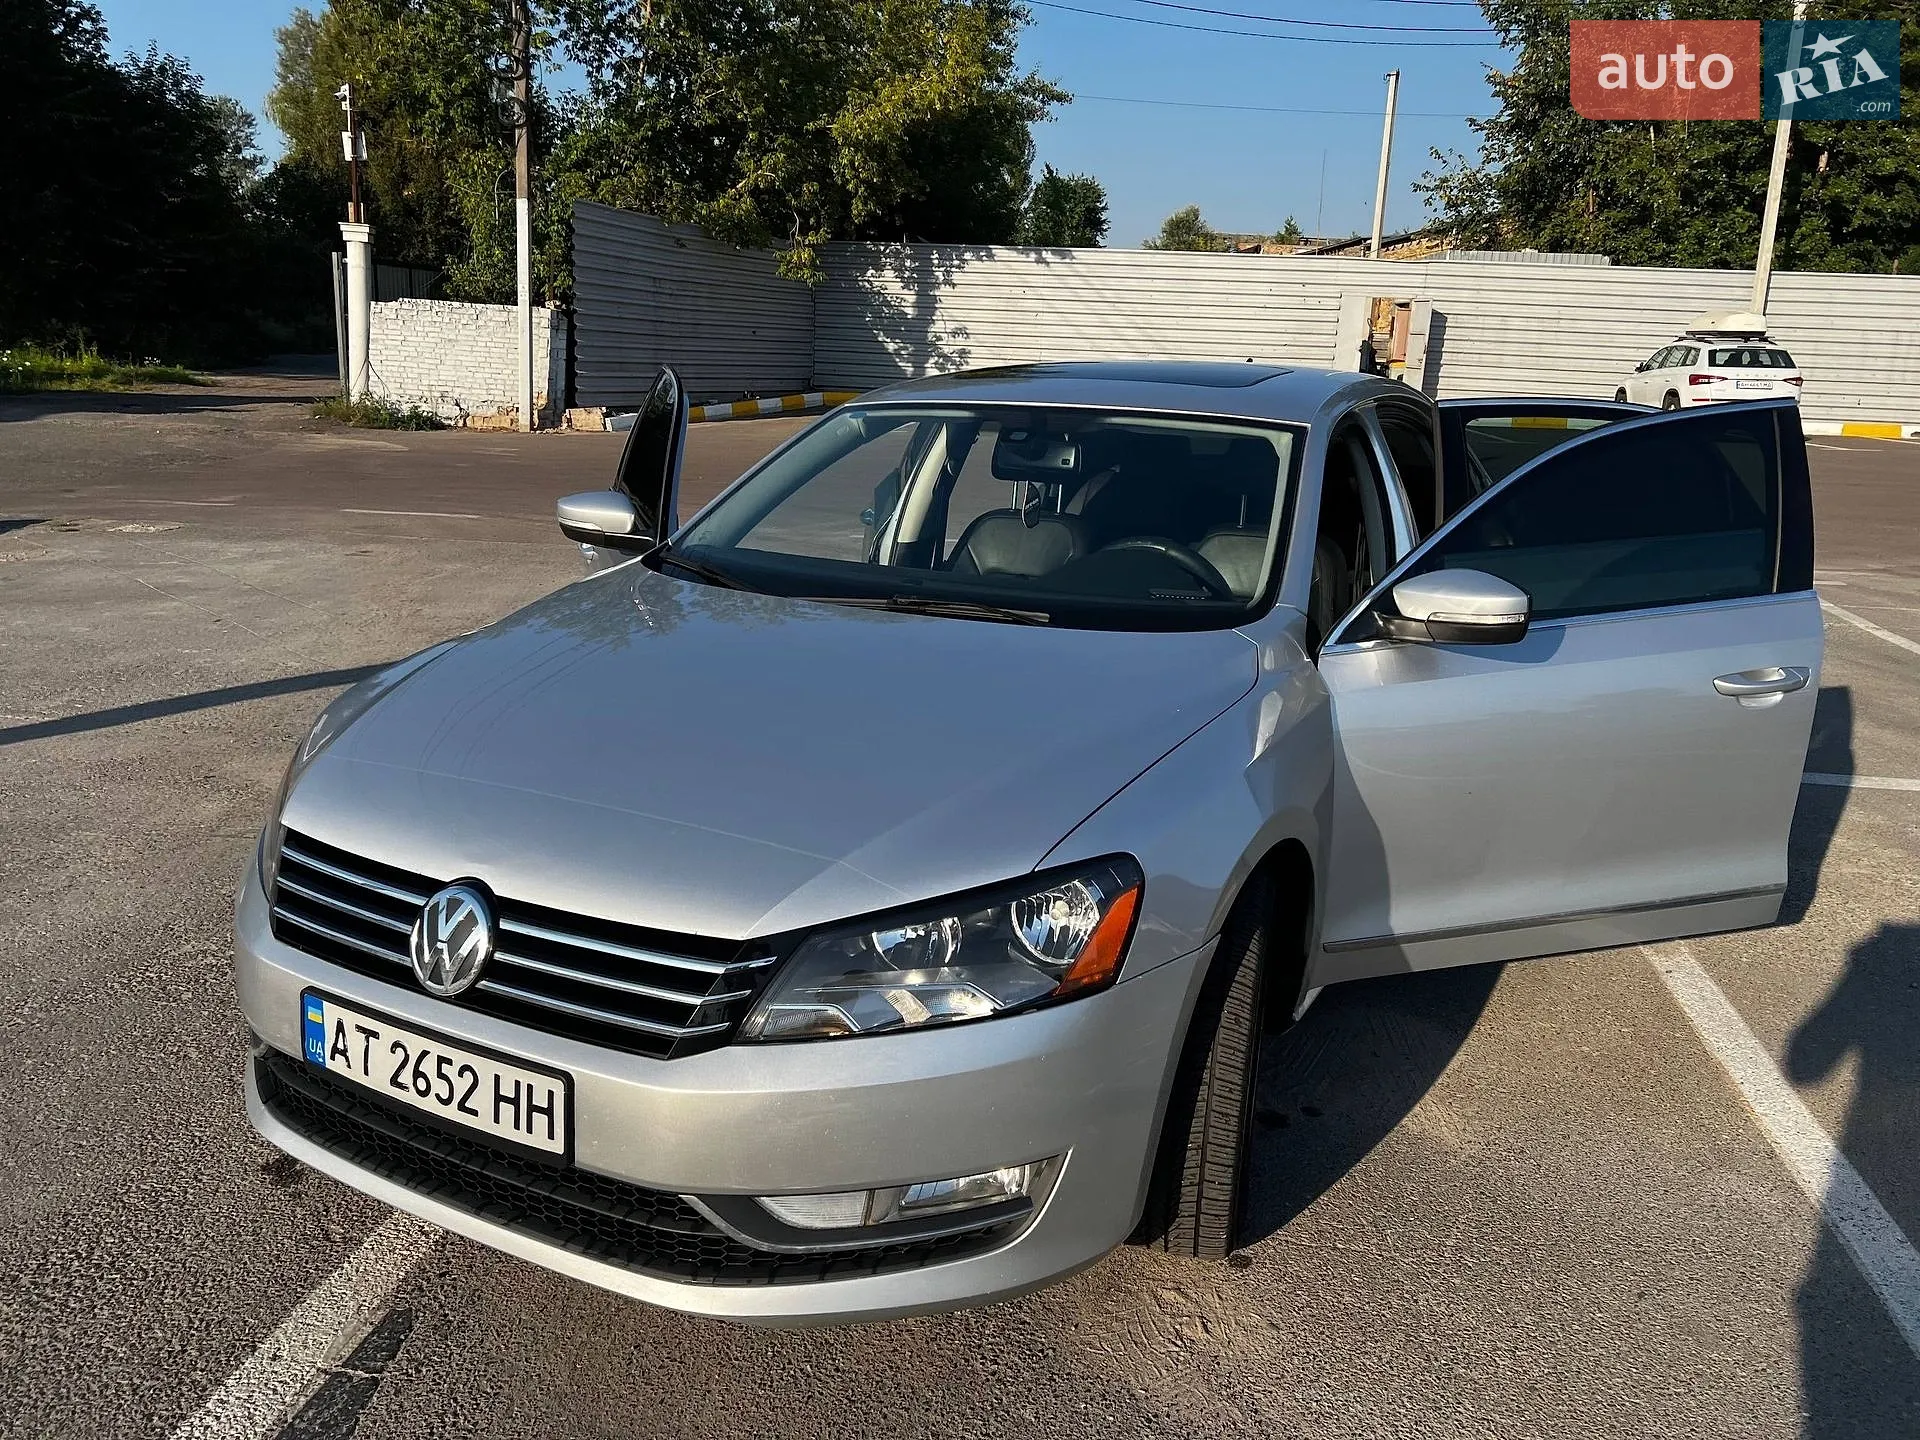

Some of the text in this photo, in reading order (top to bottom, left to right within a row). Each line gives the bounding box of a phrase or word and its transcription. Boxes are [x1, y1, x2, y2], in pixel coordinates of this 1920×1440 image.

[410, 886, 490, 995] VW
[309, 1037, 324, 1056] UA
[330, 1017, 555, 1141] AT 2652 HH
